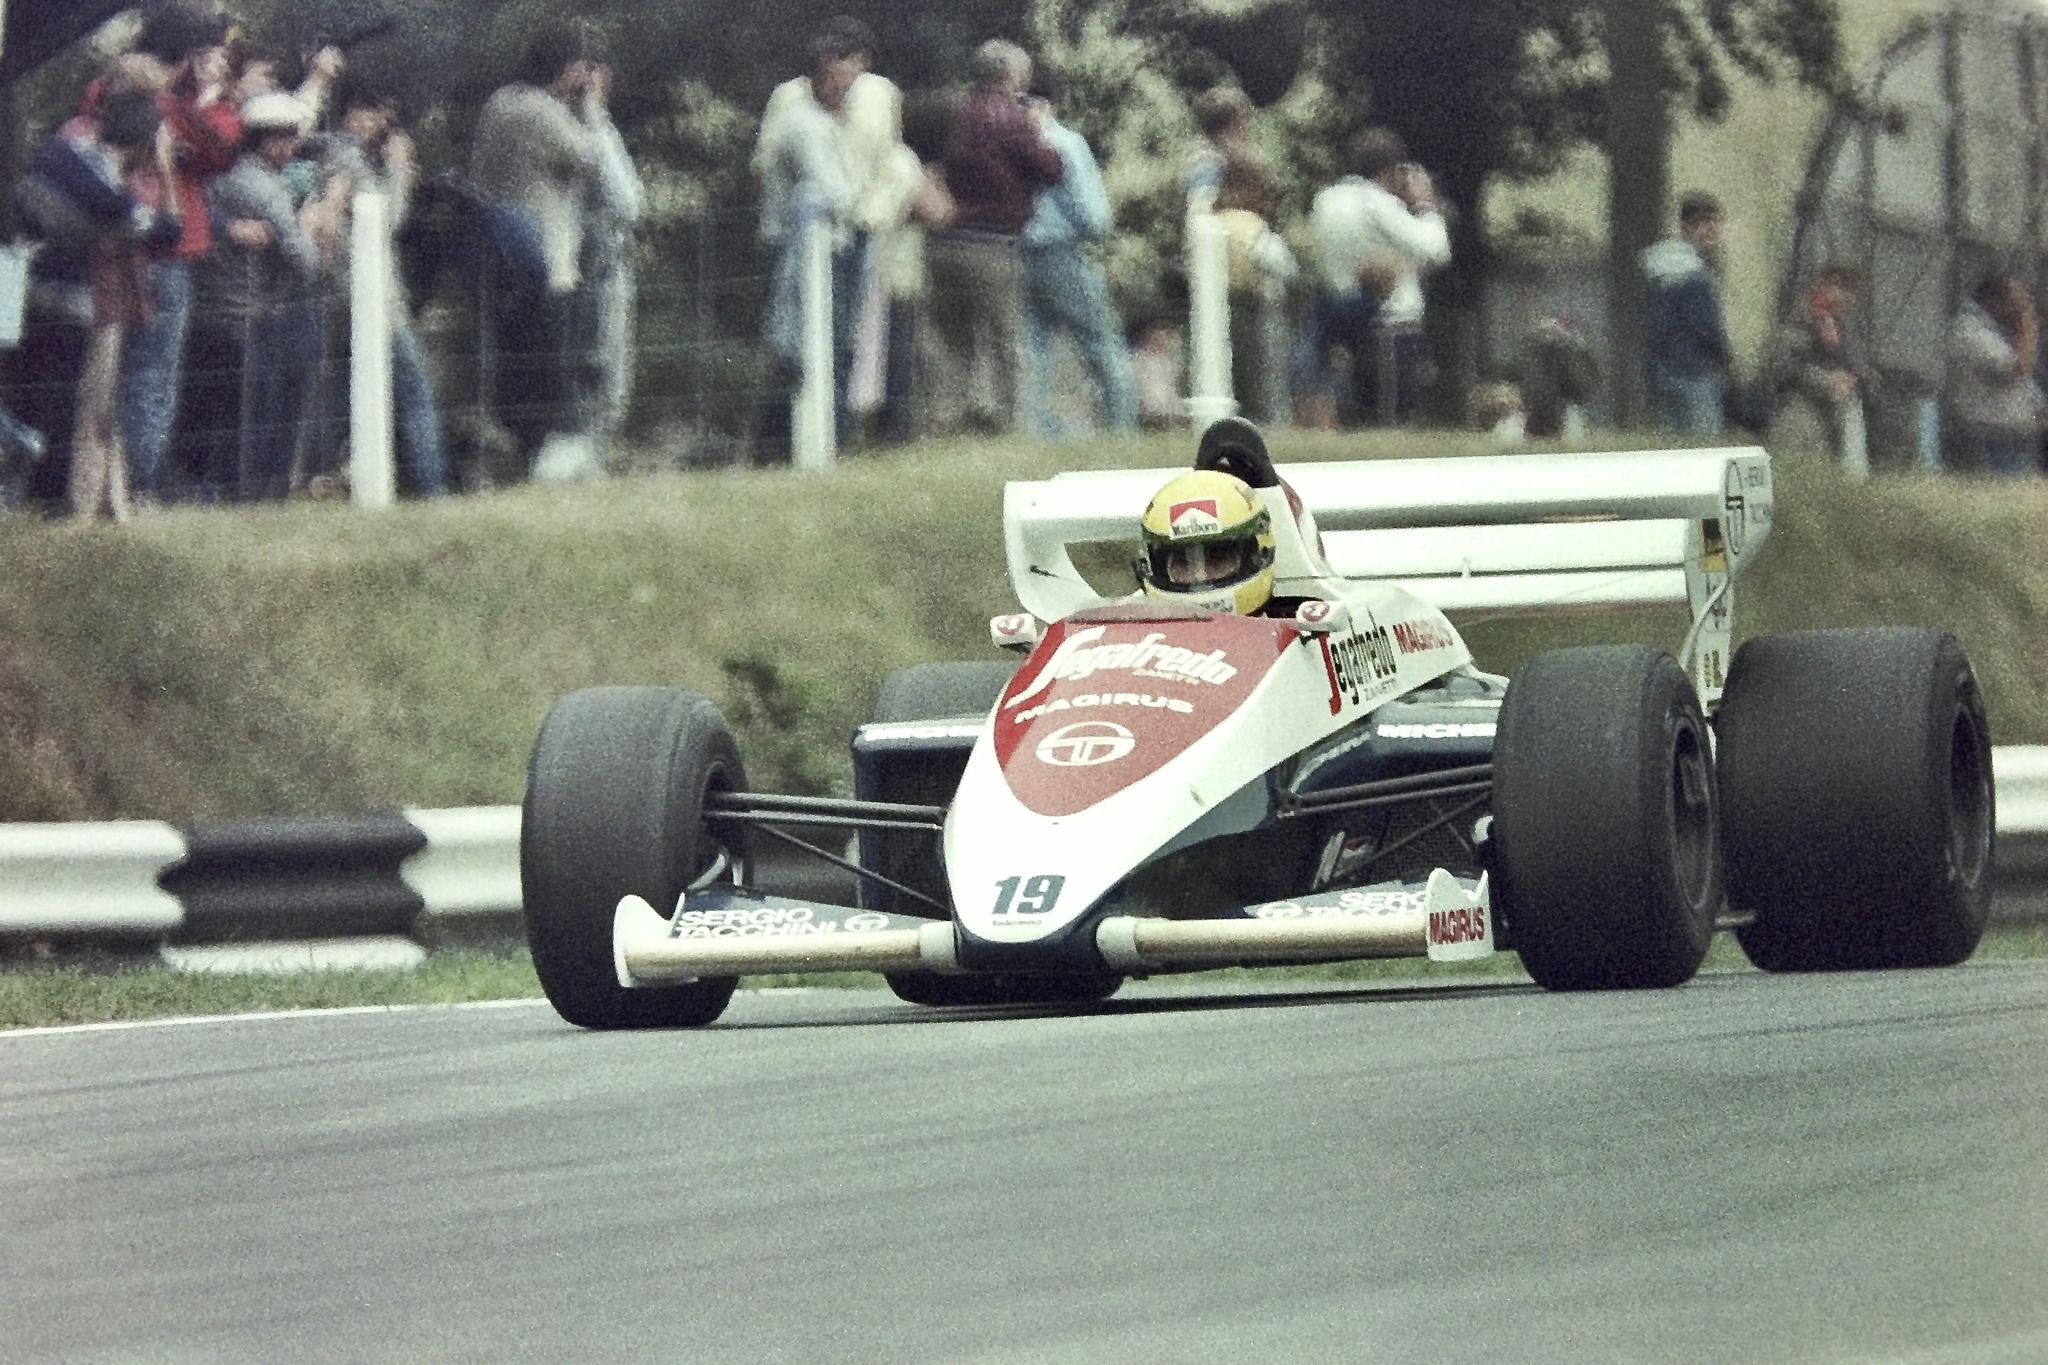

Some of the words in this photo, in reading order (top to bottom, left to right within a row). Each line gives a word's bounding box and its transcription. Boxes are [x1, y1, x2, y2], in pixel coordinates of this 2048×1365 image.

[1004, 625, 1238, 709] Segafredo
[1013, 692, 1194, 725] MAGIRUS
[992, 875, 1066, 914] 19
[675, 921, 837, 940] TACCHINI
[678, 907, 814, 927] SERGIO
[1429, 906, 1485, 945] MAGIRUS
